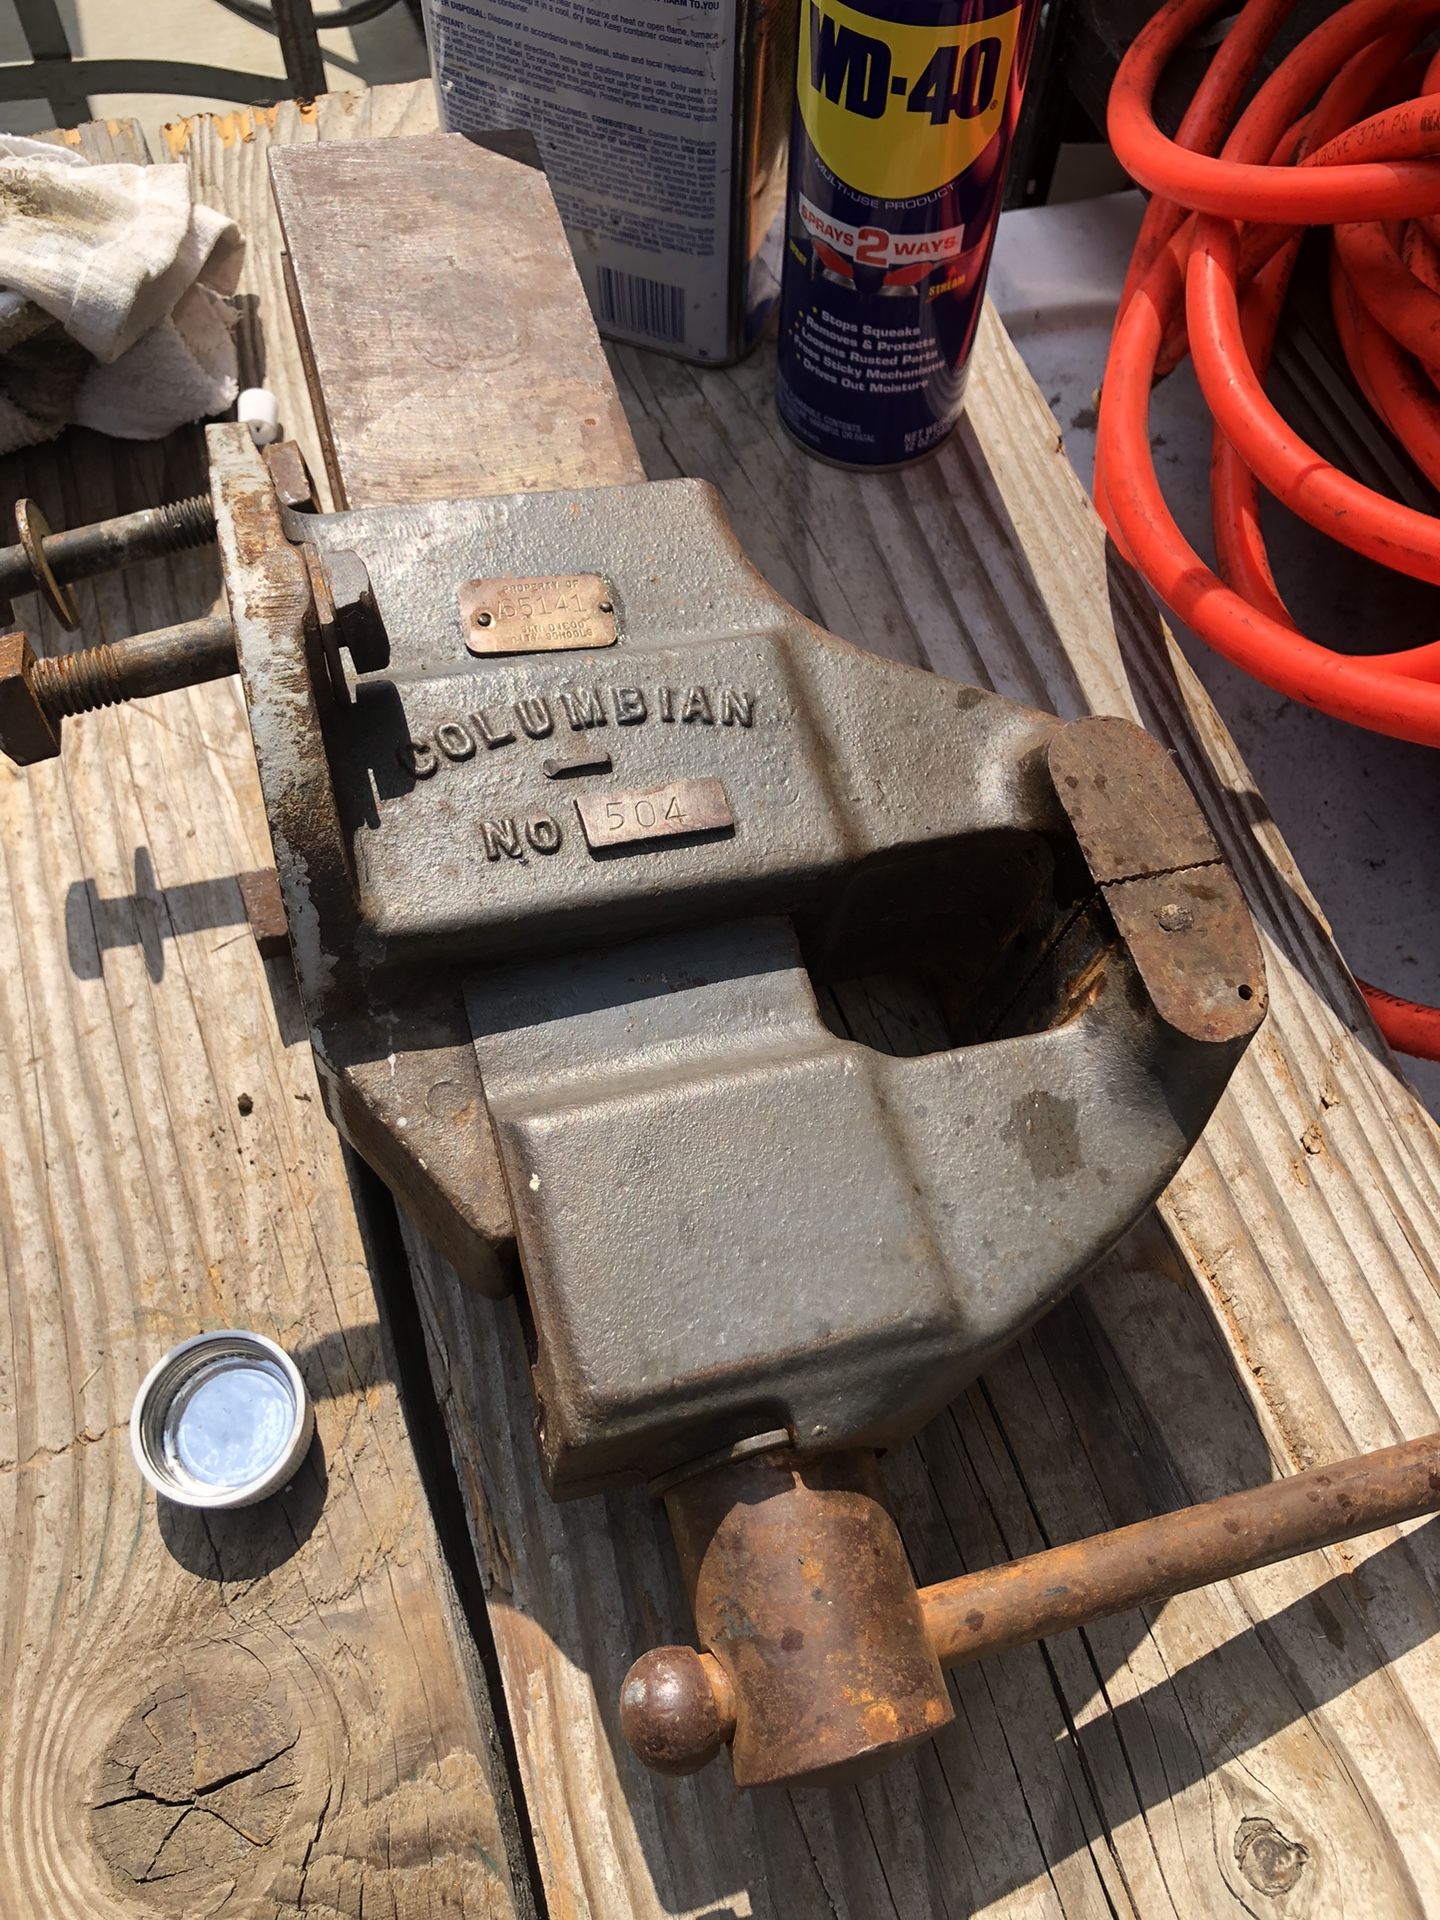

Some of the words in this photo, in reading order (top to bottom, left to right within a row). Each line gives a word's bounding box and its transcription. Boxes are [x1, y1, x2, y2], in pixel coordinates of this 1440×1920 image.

[450, 0, 488, 19] DISPOSAL:
[488, 12, 514, 28] Dispose
[530, 27, 568, 45] accordance
[702, 1, 719, 10] YOU
[572, 12, 584, 23] dry
[603, 20, 622, 33] Keep
[622, 26, 657, 41] container
[658, 33, 682, 45] closed
[586, 8, 610, 20] source
[620, 15, 637, 26] heat
[638, 20, 646, 28] or
[647, 22, 665, 31] open
[666, 25, 689, 37] flame,
[690, 29, 720, 41] furnace
[524, 43, 559, 61] directions,
[591, 114, 645, 135] COMBUSTIBLE.
[814, 157, 880, 210] MULTI-USE
[884, 181, 956, 211] PRODUCT
[800, 204, 855, 247] SPRAYS
[858, 227, 890, 267] 2
[895, 235, 957, 257] WAYS
[928, 273, 967, 298] STREAM
[806, 316, 858, 348] Removes
[862, 339, 873, 353] &
[876, 338, 937, 355] Protects
[821, 310, 858, 334] Stops
[862, 325, 920, 341] Squeaks
[794, 334, 821, 362] Frees
[822, 356, 863, 380] Sticky
[866, 360, 946, 380] Mechanisms
[801, 327, 847, 360] Loosens
[849, 351, 899, 367] Rusted
[901, 351, 939, 366] Parts
[802, 358, 838, 385] Drives
[840, 378, 867, 393] Out
[868, 379, 930, 395] Moisture
[502, 580, 559, 595] PROPERTY
[566, 579, 580, 591] OF
[409, 685, 754, 780] COLUMBIAN
[607, 796, 688, 832] 504
